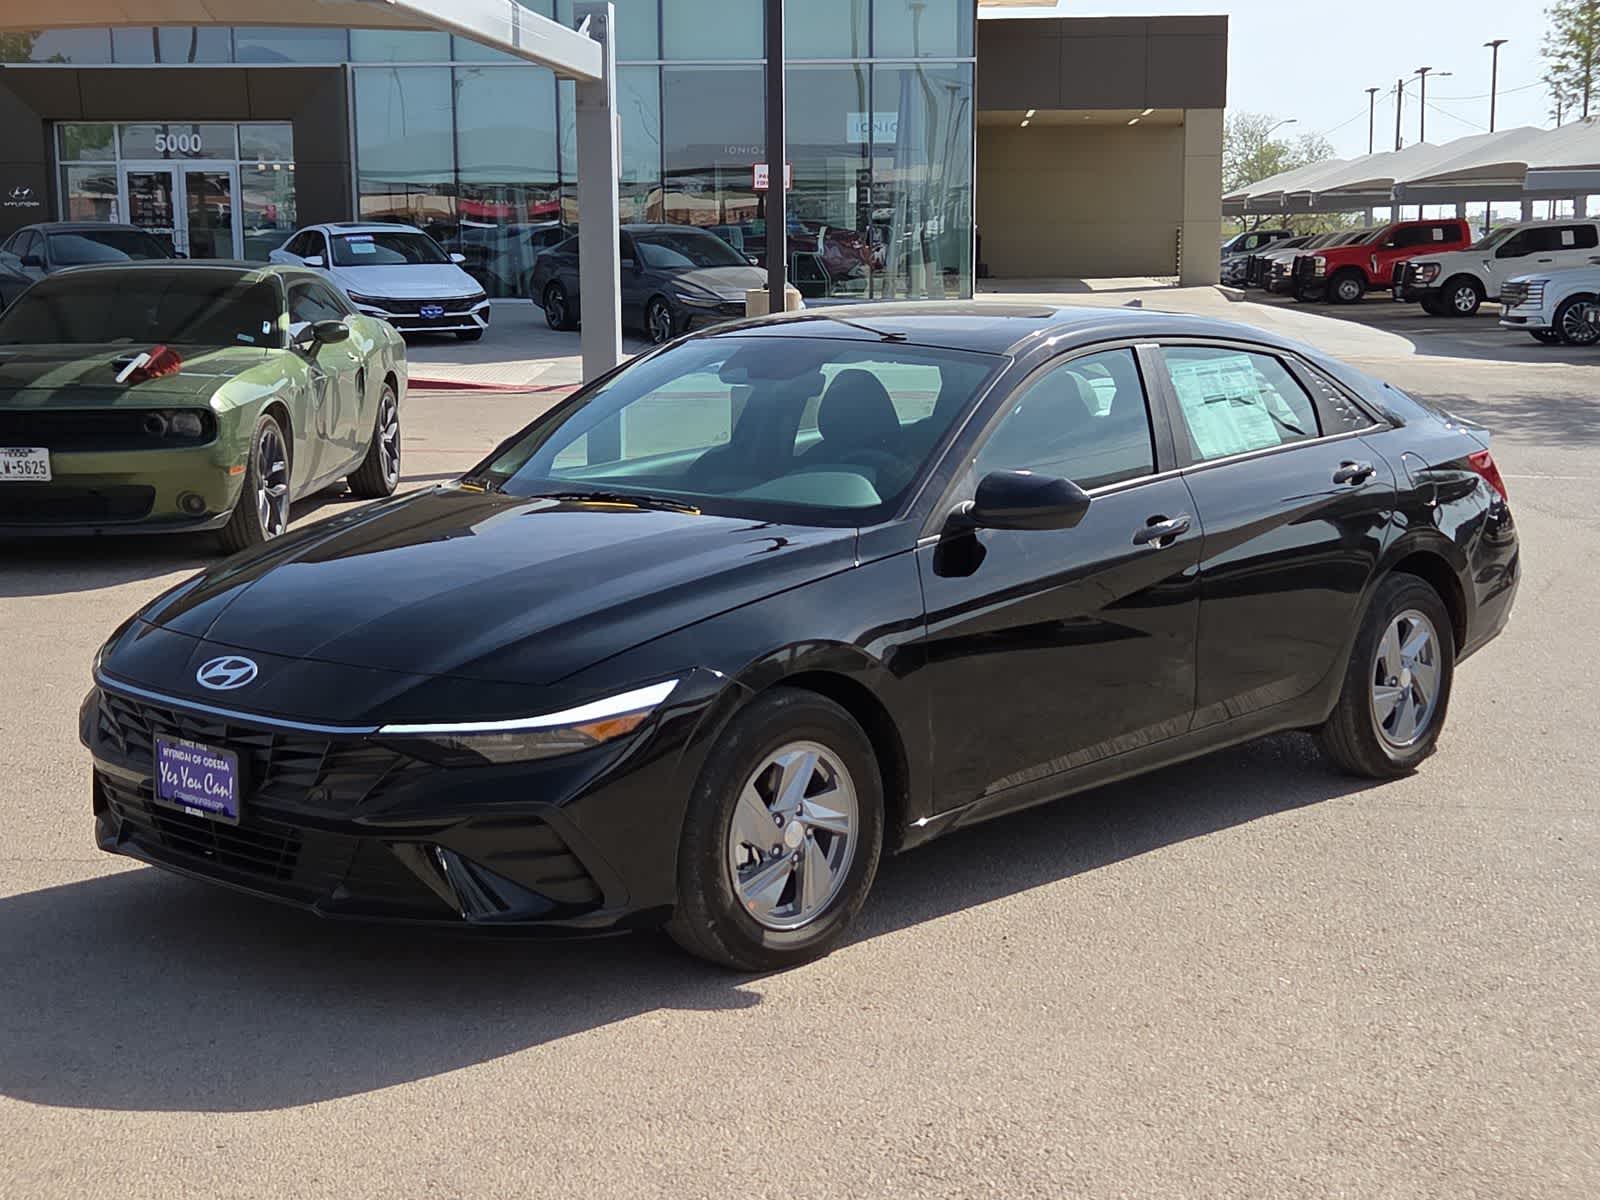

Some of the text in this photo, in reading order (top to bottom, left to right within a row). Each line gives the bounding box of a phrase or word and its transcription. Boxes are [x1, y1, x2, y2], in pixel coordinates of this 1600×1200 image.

[155, 134, 202, 152] 5000
[160, 761, 179, 786] Yes
[180, 766, 203, 789] You
[204, 773, 233, 801] Can!
